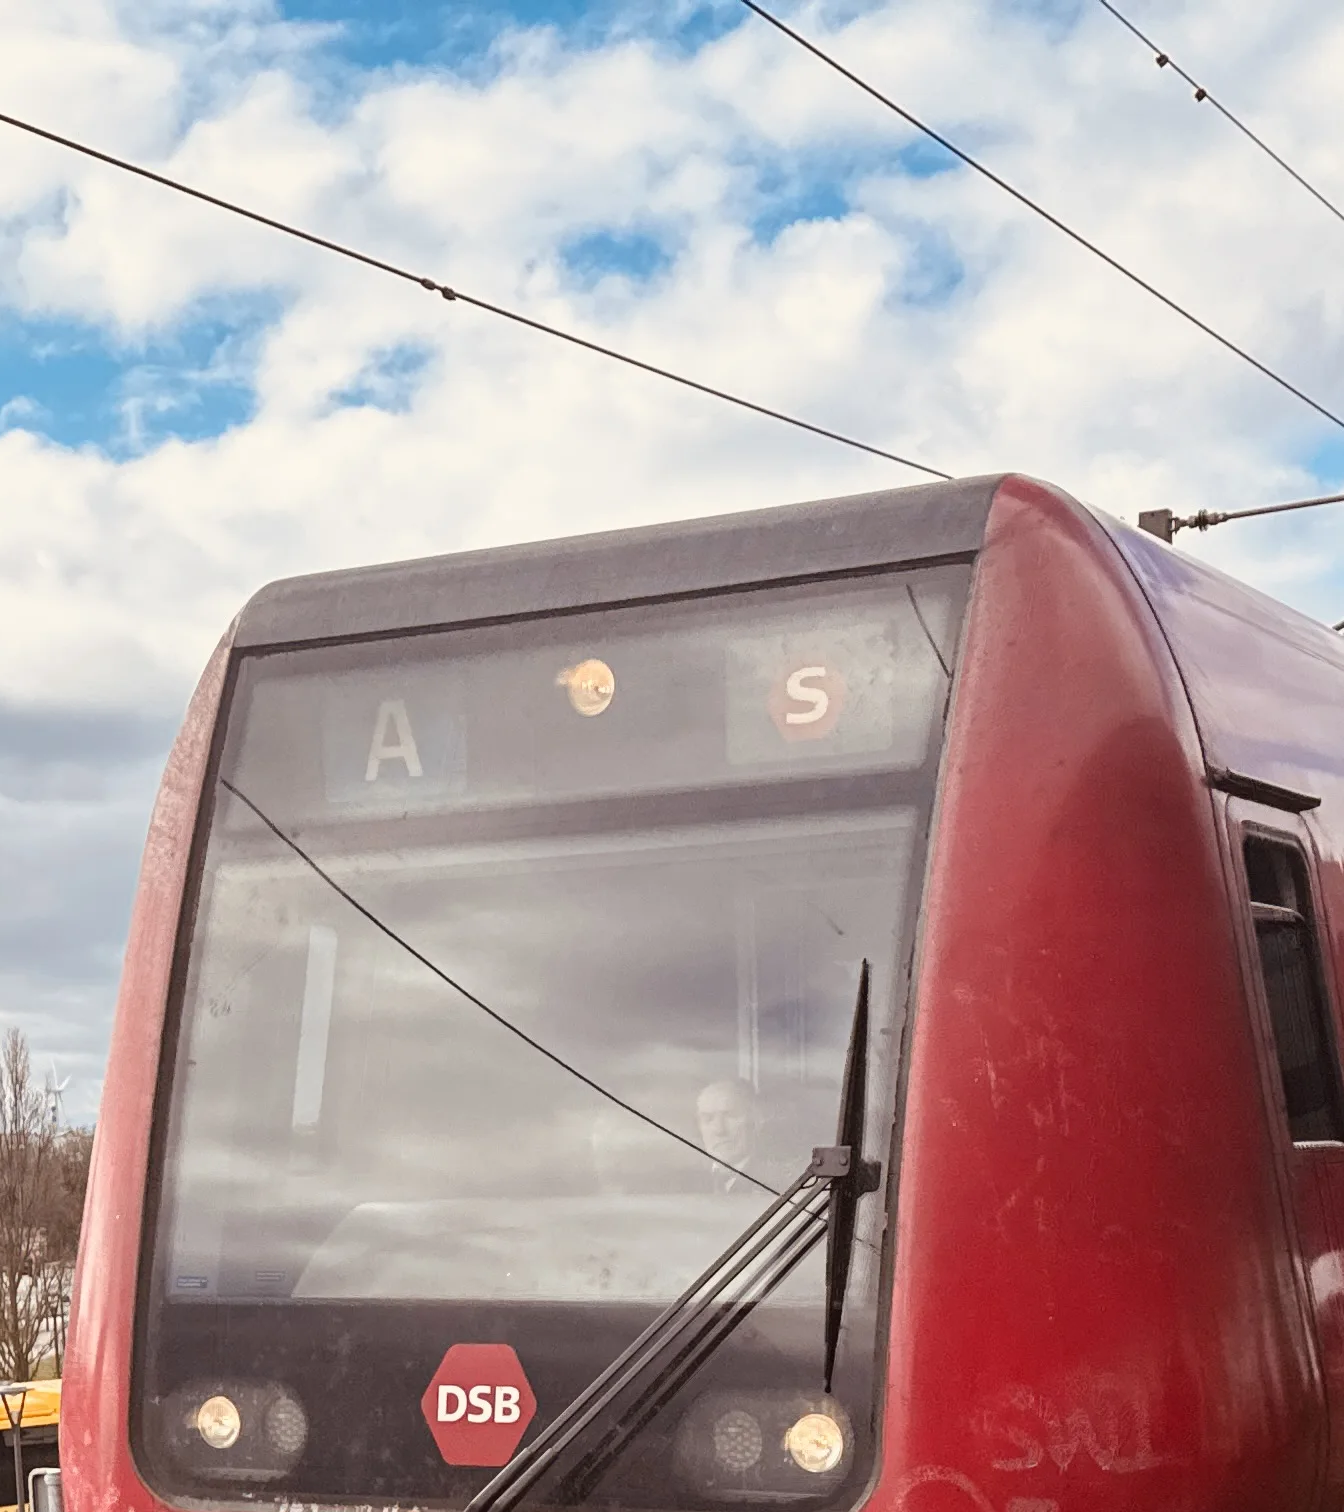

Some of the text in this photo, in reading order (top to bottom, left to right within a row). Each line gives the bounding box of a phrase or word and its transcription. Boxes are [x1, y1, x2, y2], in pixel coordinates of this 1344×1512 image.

[786, 666, 828, 724] S
[365, 699, 423, 781] A
[437, 1385, 521, 1424] DSB
